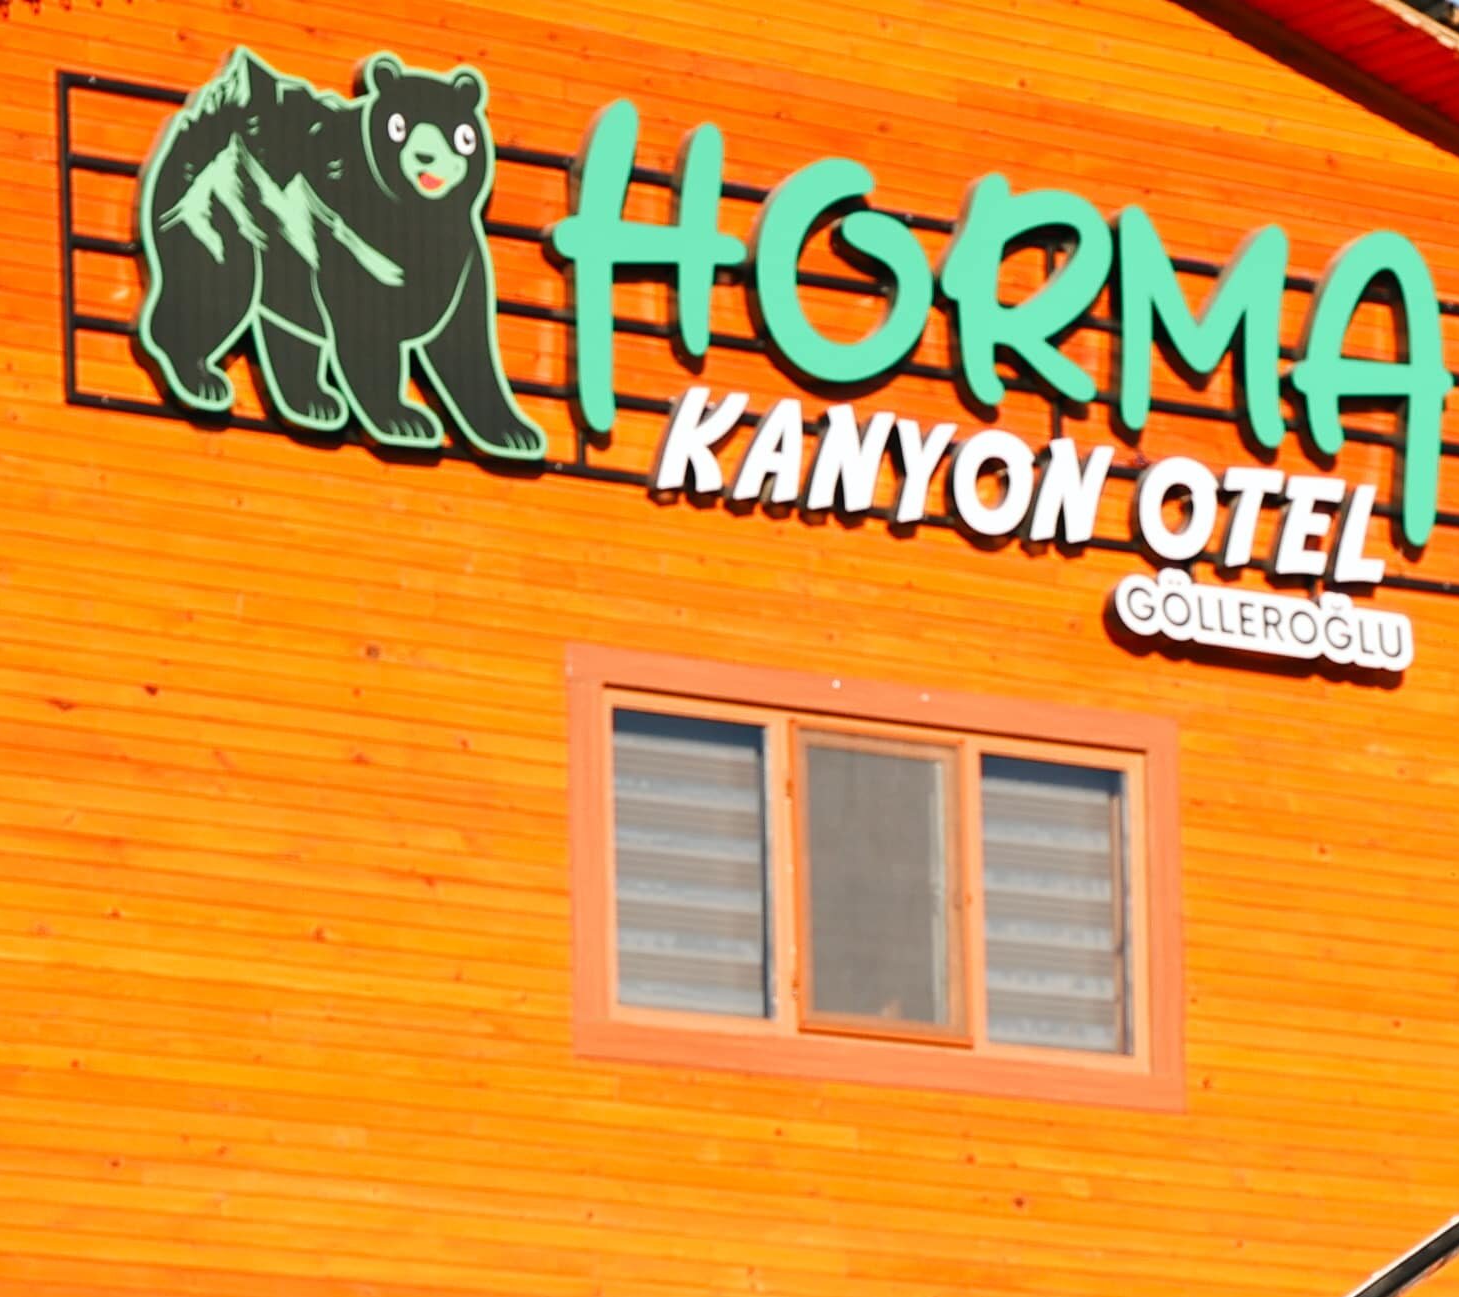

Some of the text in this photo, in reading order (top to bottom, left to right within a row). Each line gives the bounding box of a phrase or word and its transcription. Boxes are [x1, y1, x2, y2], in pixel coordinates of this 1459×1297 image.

[552, 98, 1455, 547] HORMA
[656, 386, 1387, 583] KANYON OTEL
[1126, 578, 1403, 659] GÖLLEROĞLU
